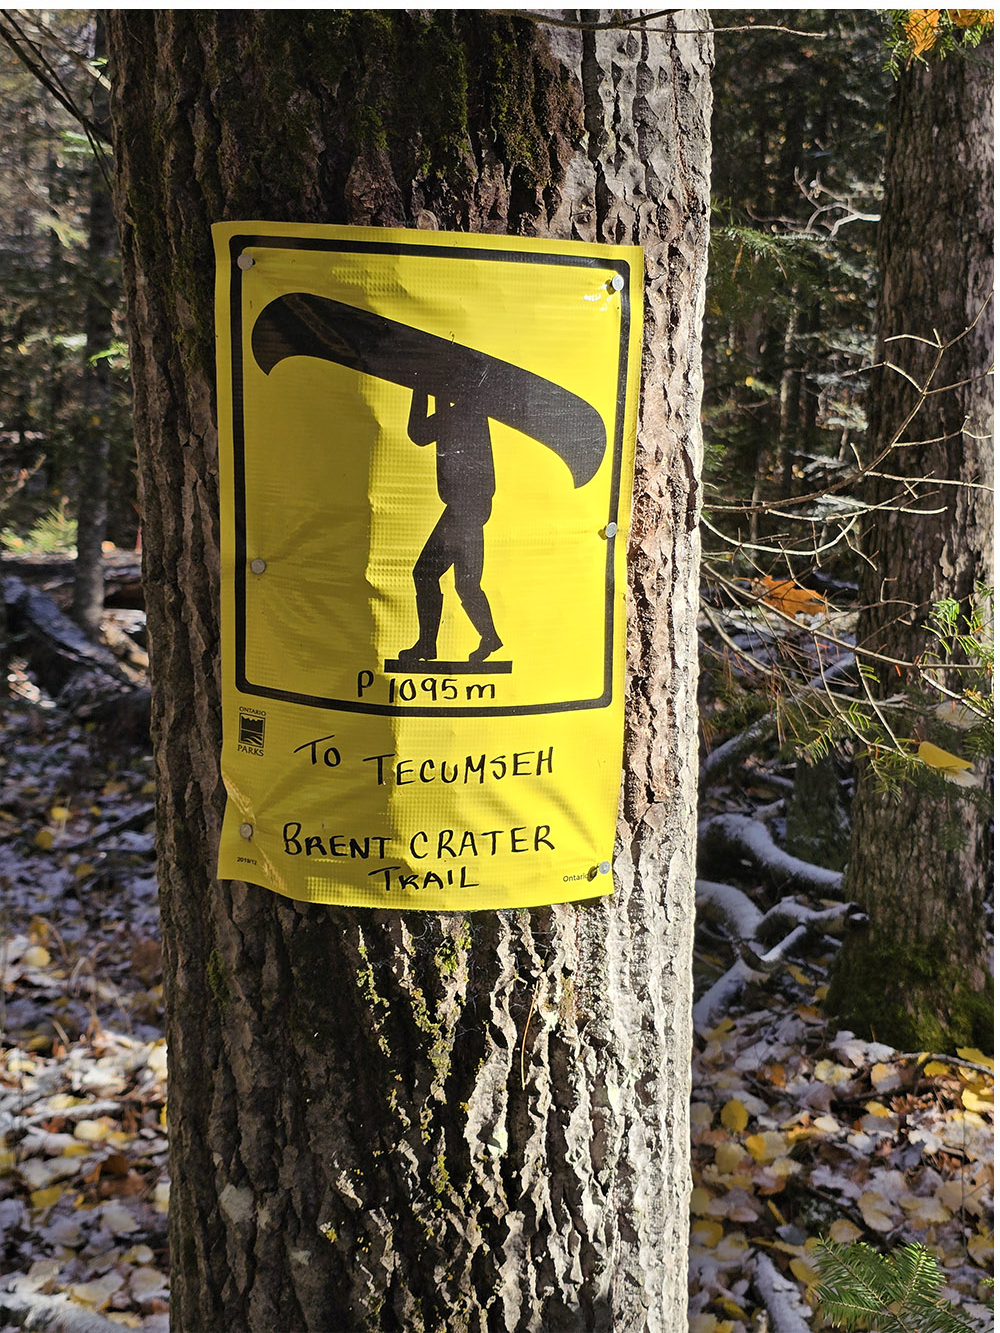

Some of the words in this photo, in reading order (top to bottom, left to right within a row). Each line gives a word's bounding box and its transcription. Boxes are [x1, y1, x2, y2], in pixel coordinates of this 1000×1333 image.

[358, 670, 374, 697] P
[239, 706, 266, 717] ONTARIO
[237, 744, 265, 757] PARKS
[363, 747, 554, 785] TECUMSEH
[283, 822, 391, 859] BRENT
[410, 825, 555, 858] CRATER
[369, 866, 479, 891] TRAIL
